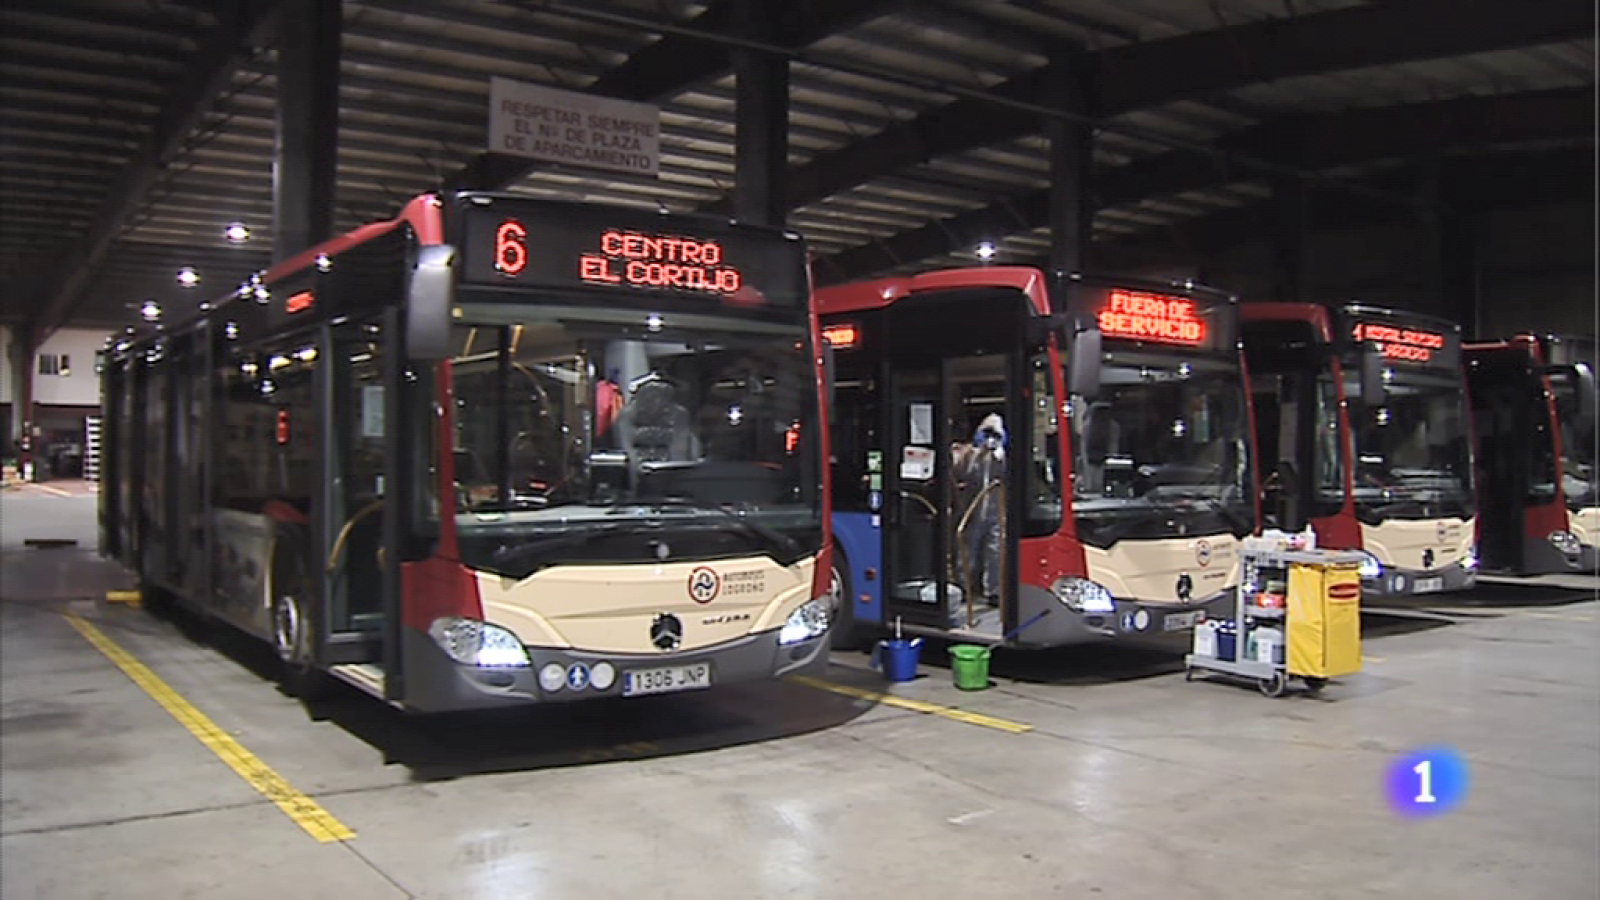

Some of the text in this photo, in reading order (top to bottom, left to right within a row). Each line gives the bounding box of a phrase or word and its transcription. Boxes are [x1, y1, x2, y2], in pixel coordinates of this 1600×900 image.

[501, 99, 655, 138] RESPETAR SIEMPRE
[513, 117, 532, 134] EL
[565, 127, 585, 144] DE
[591, 131, 641, 151] PLAZA
[504, 134, 650, 169] DE APARCAMIENTO
[497, 221, 526, 274] 6
[602, 231, 721, 265] CENTRO
[578, 254, 740, 294] EL CORTIJO
[1110, 291, 1192, 321] FUERA DE
[1099, 311, 1202, 341] SERVICIO
[635, 665, 706, 690] 1306 JNP
